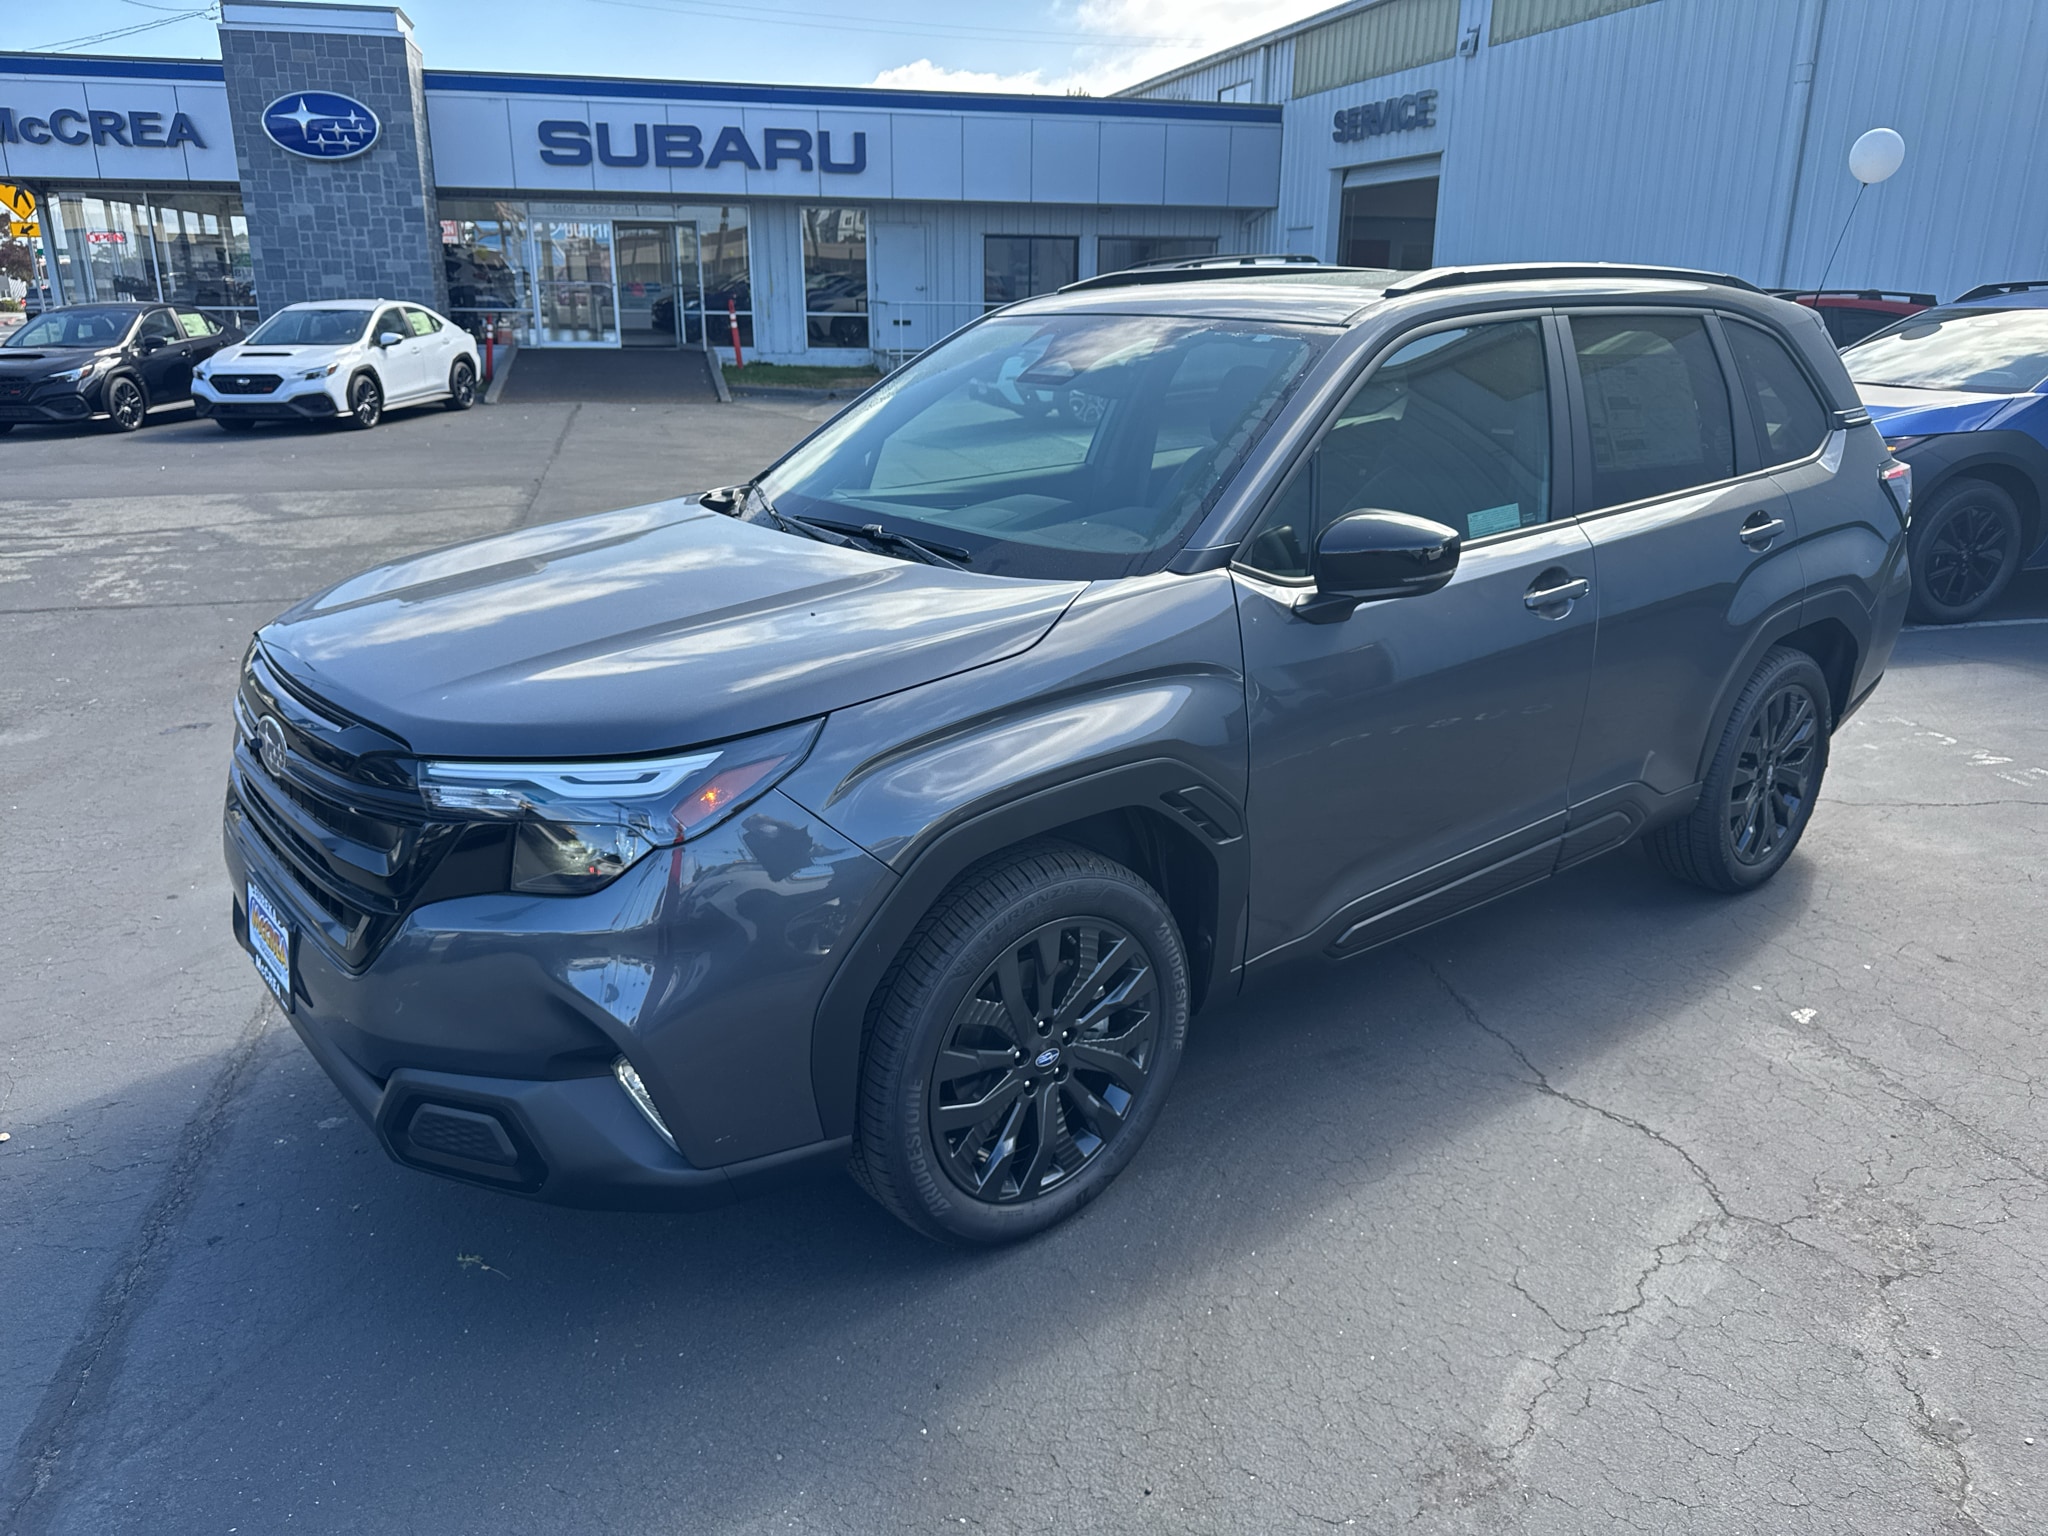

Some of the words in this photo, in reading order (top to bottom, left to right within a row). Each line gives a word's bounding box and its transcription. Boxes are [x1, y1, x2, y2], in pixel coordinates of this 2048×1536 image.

[1332, 89, 1438, 143] SERVICE
[537, 119, 867, 175] SUBARU
[86, 232, 124, 243] OPEN
[980, 885, 1076, 942] TURANZA
[1157, 921, 1187, 1050] BRIDGESTONE
[905, 1079, 952, 1217] BRIDGESTONE
